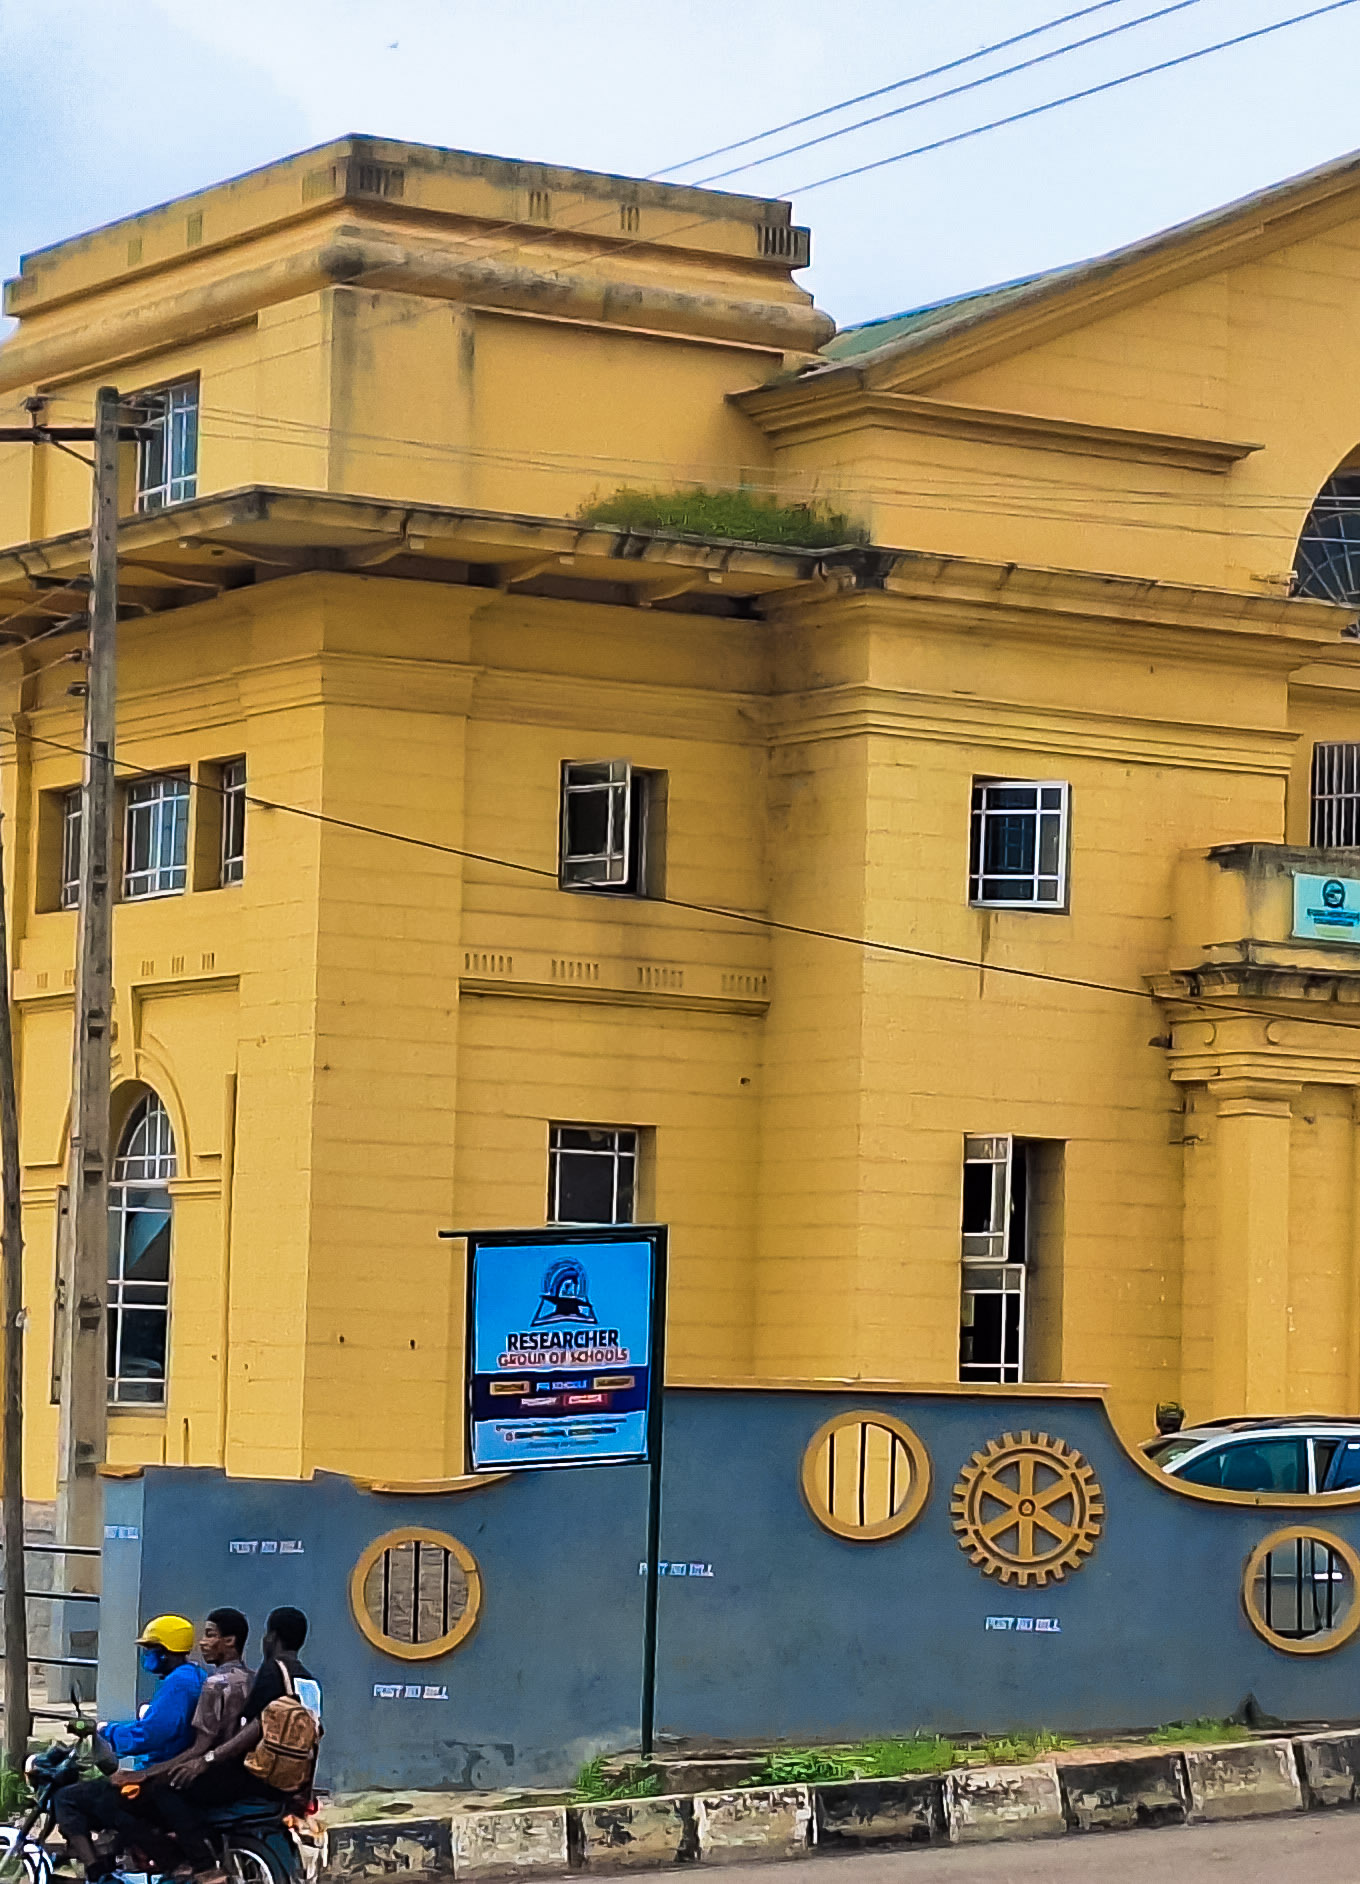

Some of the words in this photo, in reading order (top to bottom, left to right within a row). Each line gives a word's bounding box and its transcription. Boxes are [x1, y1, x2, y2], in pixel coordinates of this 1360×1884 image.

[506, 1328, 620, 1351] RESEARCHER
[498, 1352, 546, 1367] GROUP
[548, 1351, 567, 1365] OF
[571, 1347, 629, 1363] SCHOOLS
